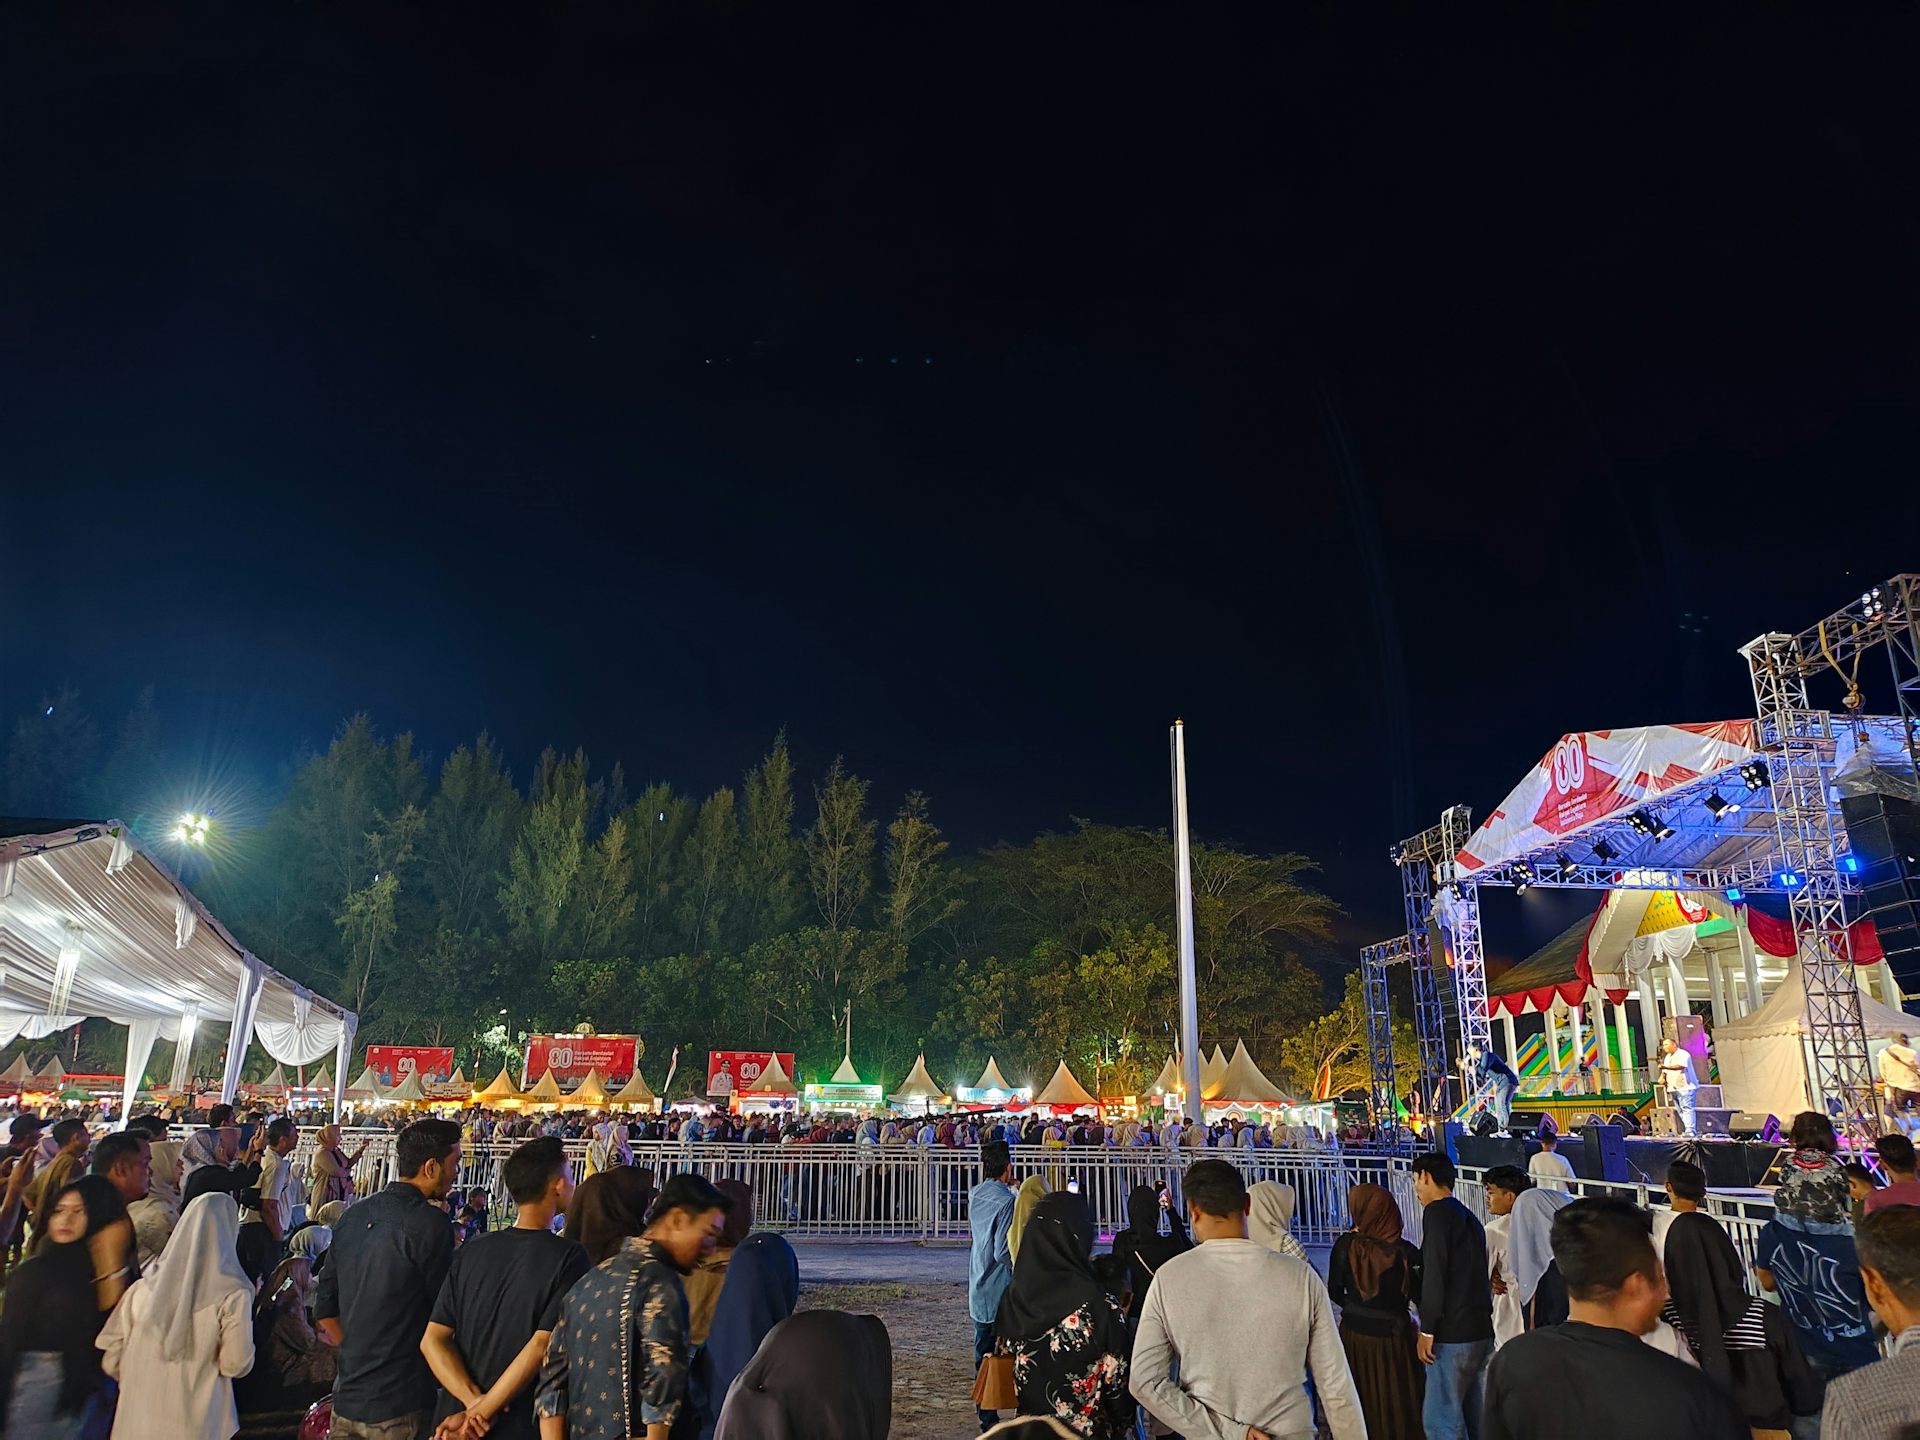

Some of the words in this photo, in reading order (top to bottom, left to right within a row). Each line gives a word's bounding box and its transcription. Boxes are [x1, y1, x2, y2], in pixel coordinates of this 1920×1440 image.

[1554, 734, 1585, 795] 80
[398, 1057, 416, 1072] 80
[548, 1047, 573, 1069] 80
[741, 1062, 760, 1079] 80
[1769, 1241, 1862, 1330] NY
